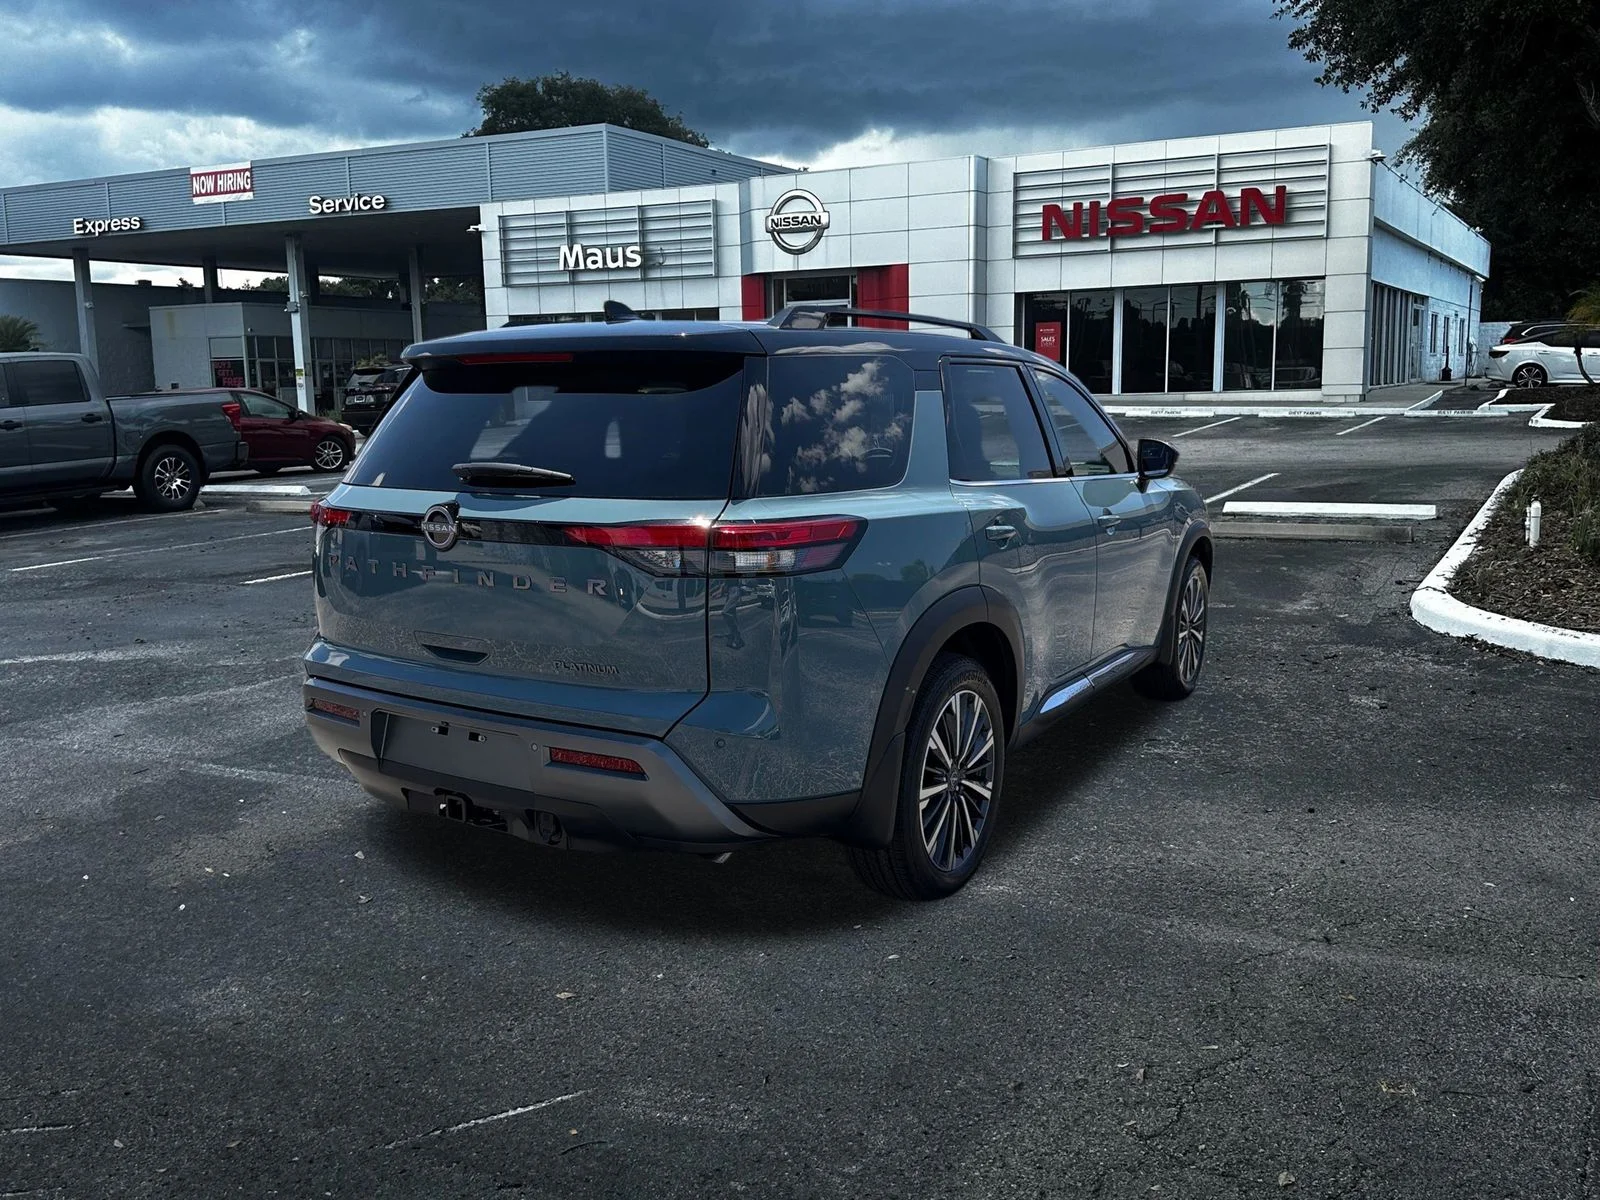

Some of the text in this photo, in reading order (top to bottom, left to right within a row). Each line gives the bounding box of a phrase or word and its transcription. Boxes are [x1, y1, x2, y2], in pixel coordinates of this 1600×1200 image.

[192, 172, 252, 195] NOW HIRING
[308, 193, 386, 215] Service
[1042, 185, 1287, 241] NISSAN
[73, 216, 141, 237] Express
[770, 214, 822, 229] NISSAN
[559, 243, 642, 271] Maus
[222, 376, 244, 386] FREE
[421, 522, 457, 532] NISSAN
[328, 553, 609, 596] PATHFINDER
[554, 661, 620, 675] PLATINUM
